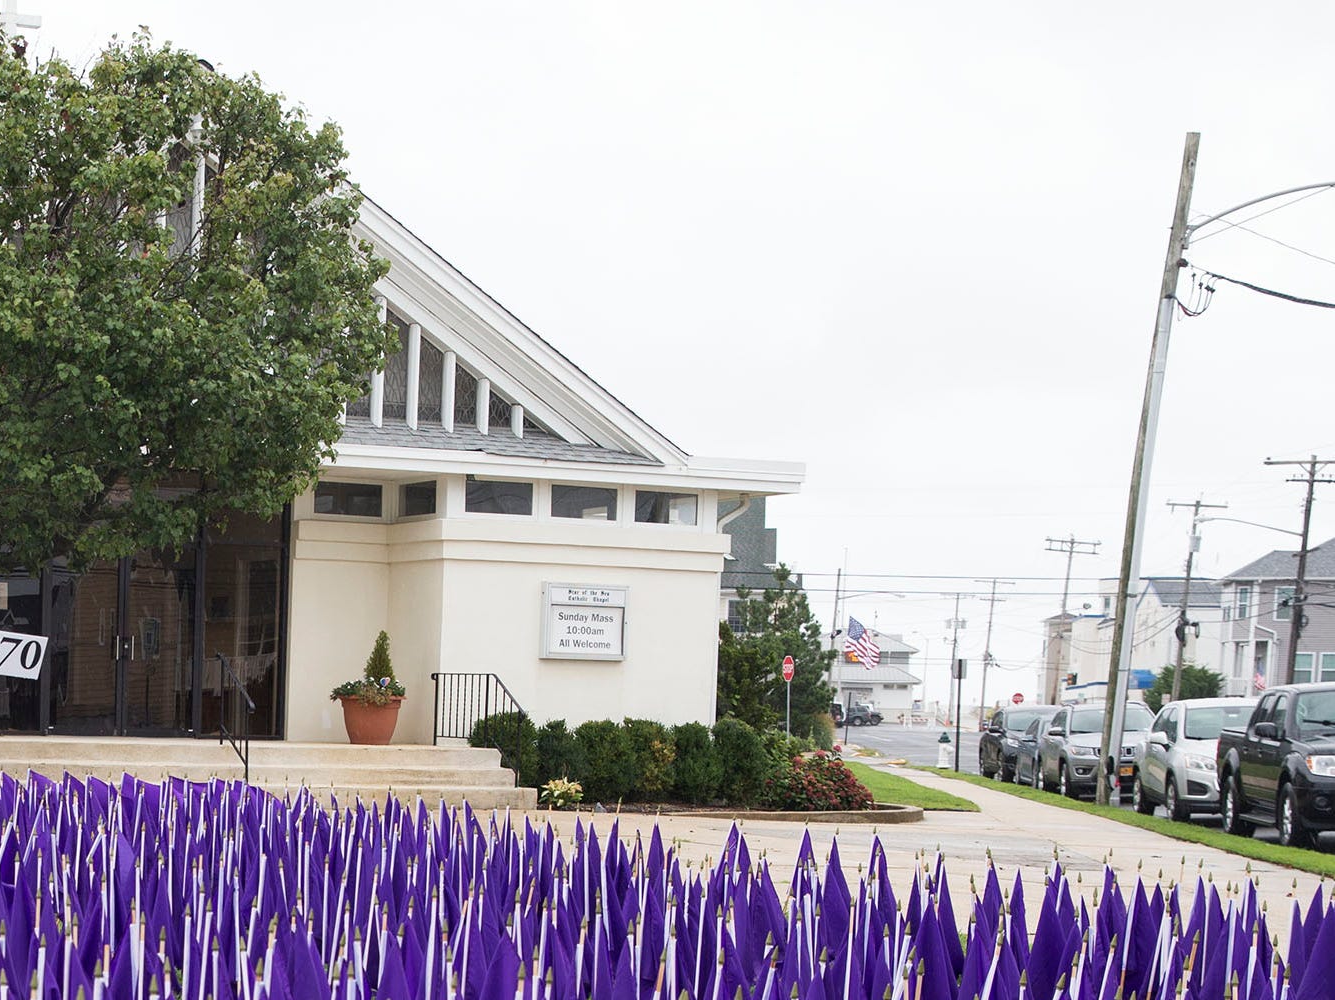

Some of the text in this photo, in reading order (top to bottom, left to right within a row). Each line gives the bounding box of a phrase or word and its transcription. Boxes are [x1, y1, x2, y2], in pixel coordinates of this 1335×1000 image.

[558, 611, 614, 624] Sunday Mass
[566, 626, 604, 636] 10:00am
[559, 639, 611, 649] All Welcome
